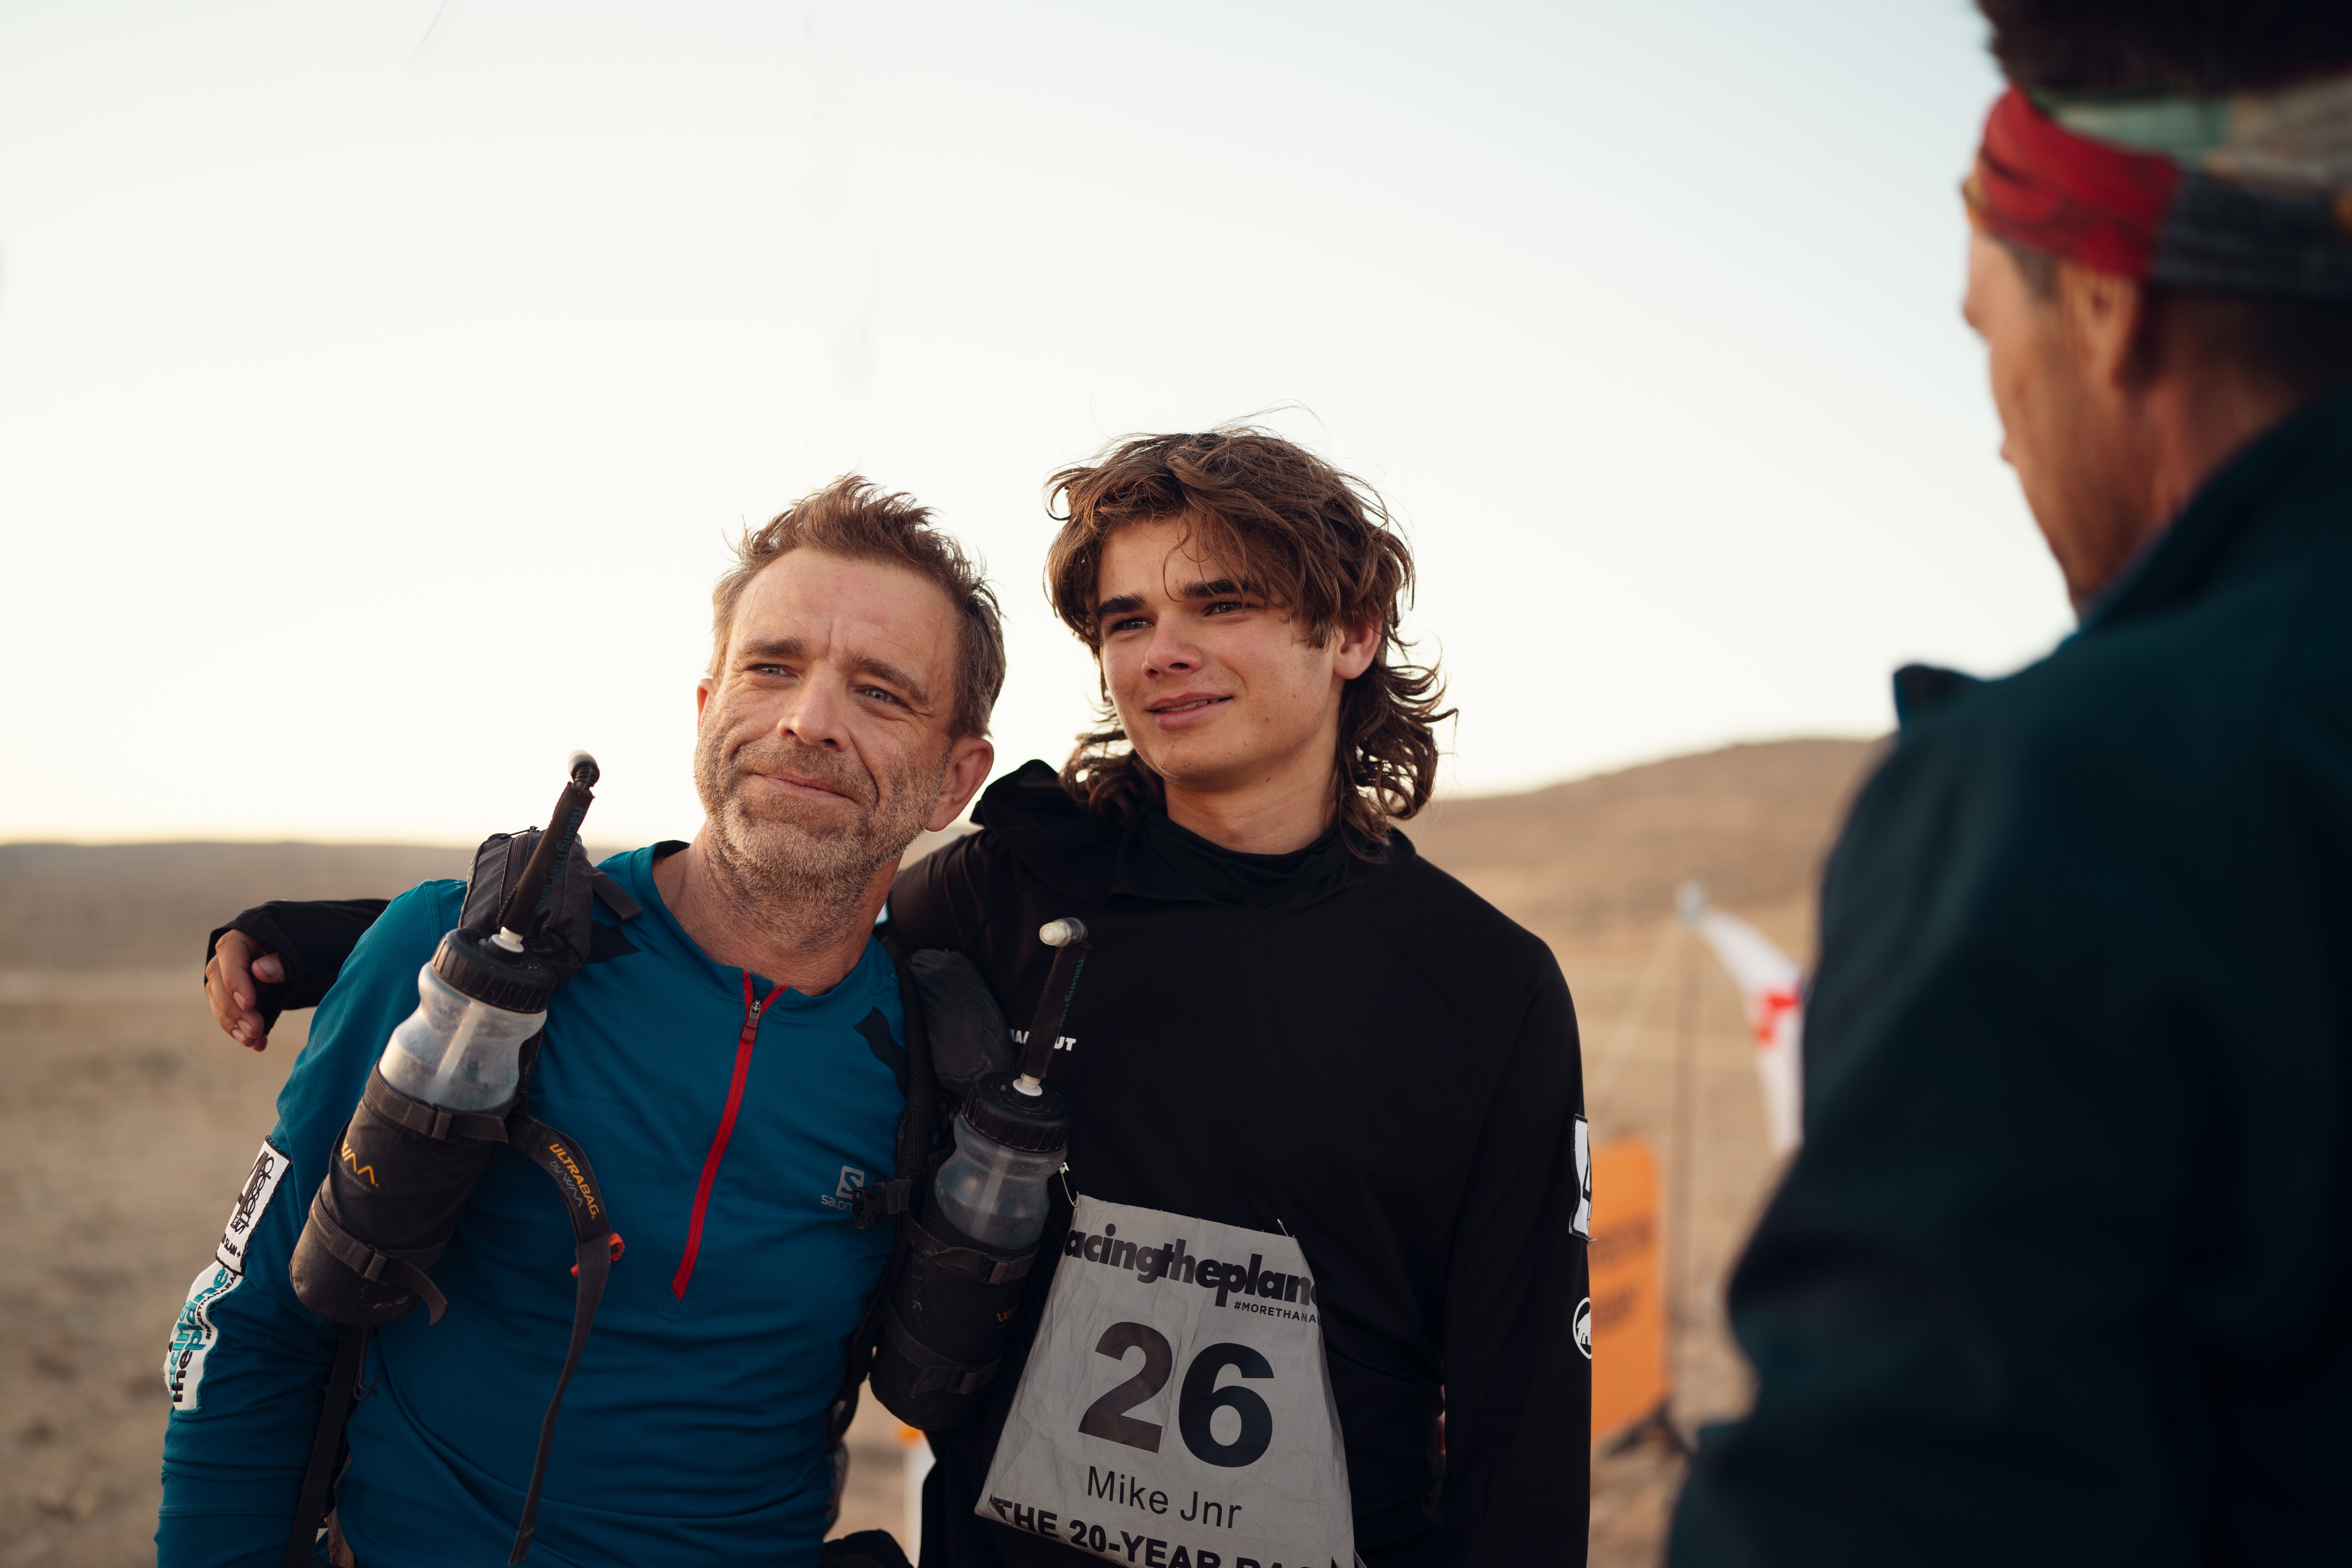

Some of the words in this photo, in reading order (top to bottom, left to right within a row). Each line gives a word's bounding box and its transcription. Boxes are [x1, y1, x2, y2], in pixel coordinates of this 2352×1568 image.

[1064, 1223, 1317, 1308] acingtheplan
[1078, 1321, 1275, 1468] 26
[993, 1497, 1060, 1539] THE
[1087, 1465, 1169, 1515] Mike
[1180, 1491, 1242, 1529] Jnr
